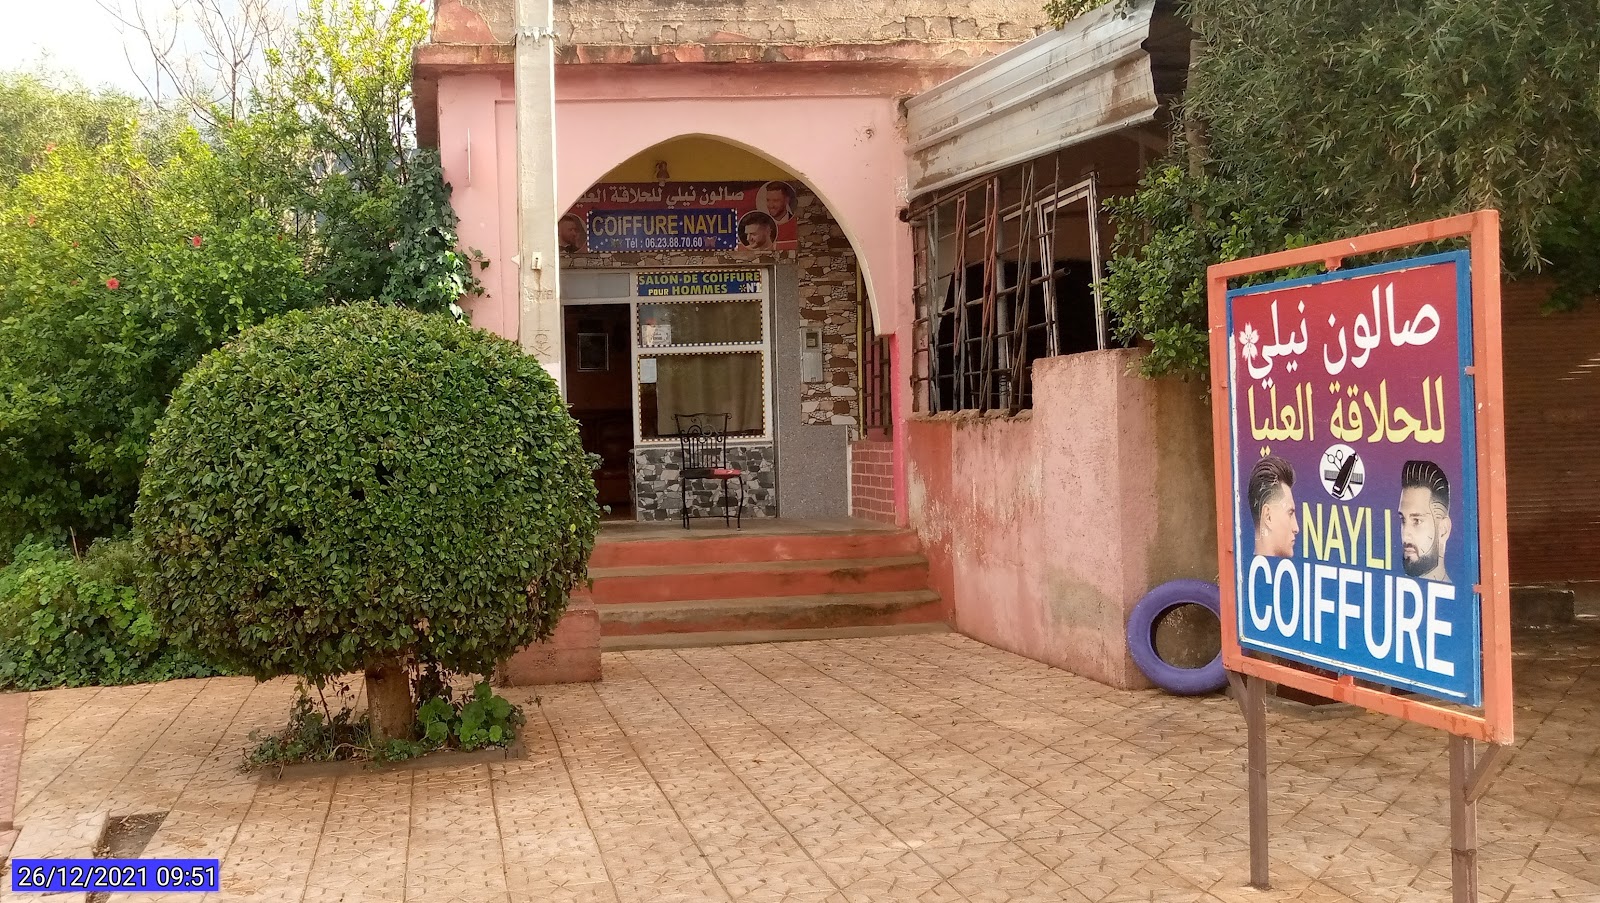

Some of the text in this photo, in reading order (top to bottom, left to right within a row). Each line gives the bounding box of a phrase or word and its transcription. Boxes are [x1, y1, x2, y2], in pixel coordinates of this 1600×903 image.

[608, 186, 663, 204] للحلاقة
[665, 185, 696, 209] نيلي
[699, 185, 744, 206] صالون
[683, 214, 732, 235] NAYLI
[624, 237, 638, 248] Tél
[645, 236, 703, 247] 06.23.88.70.60
[639, 271, 760, 285] SALON DE COIFFURE
[672, 284, 728, 295] HOMMES
[1247, 282, 1441, 390] صالون نيلي
[1247, 375, 1446, 457] للحلاقة العليا
[1302, 501, 1392, 571] NAYLI
[1248, 555, 1456, 676] COIFFURE
